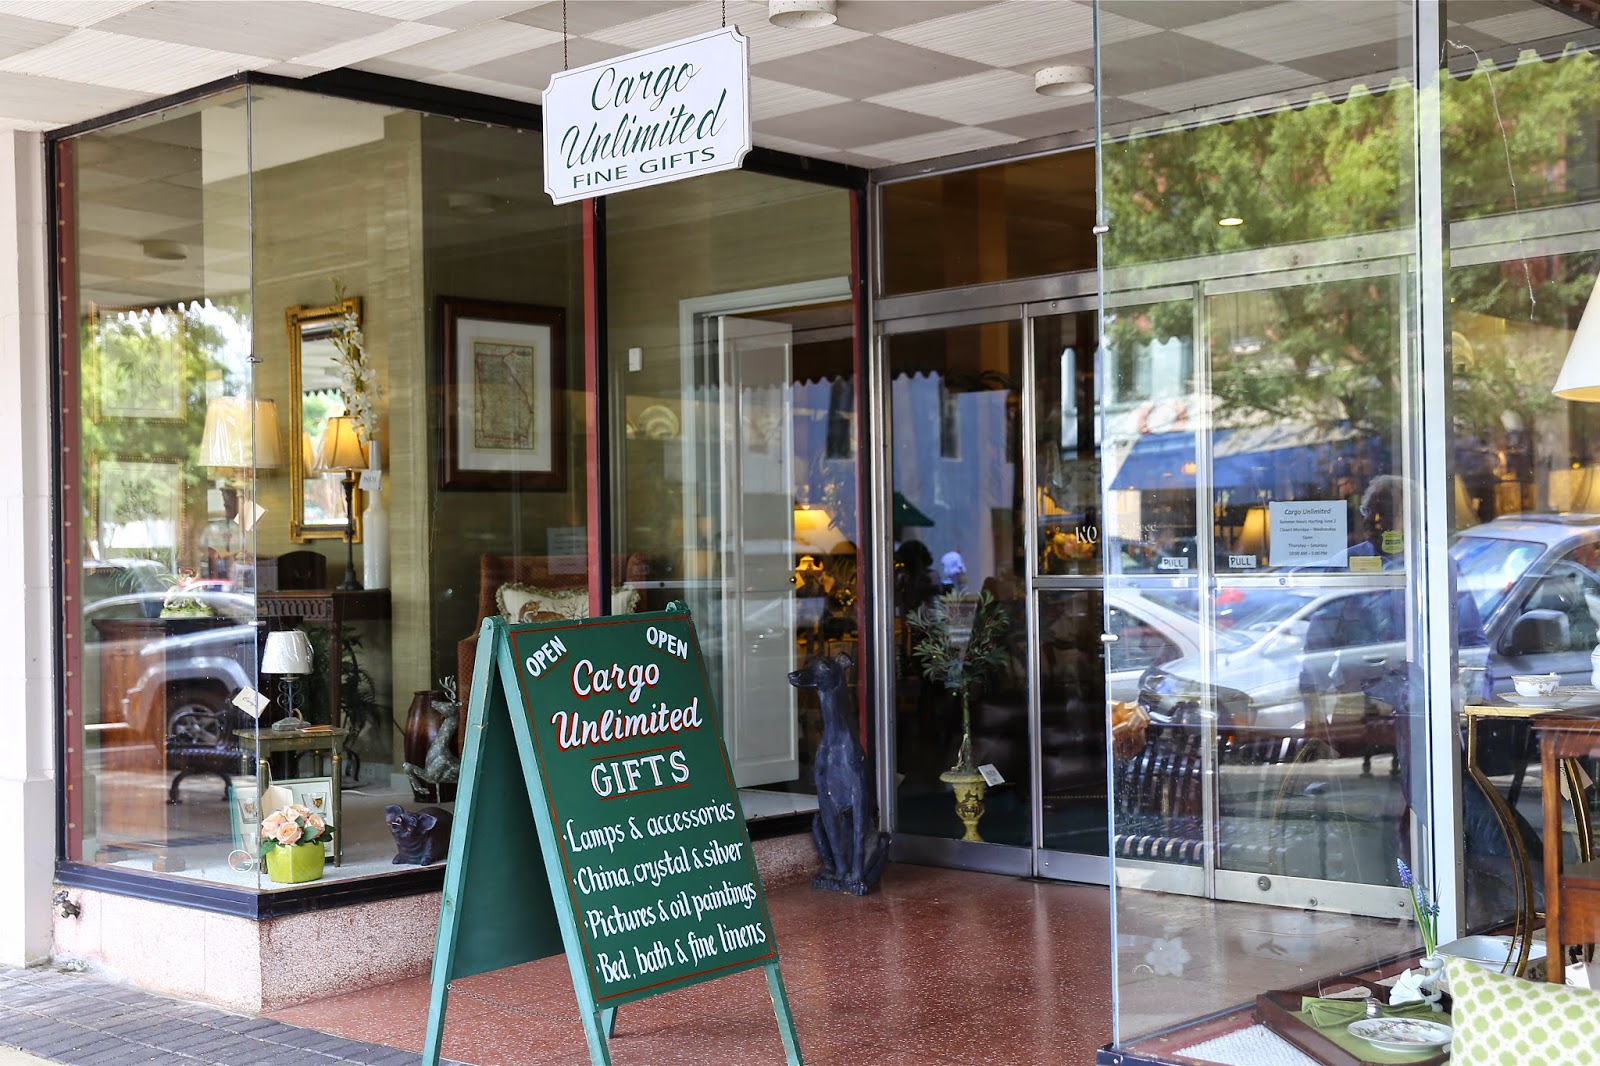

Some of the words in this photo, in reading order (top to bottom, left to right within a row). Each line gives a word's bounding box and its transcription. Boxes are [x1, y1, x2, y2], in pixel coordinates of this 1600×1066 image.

[592, 63, 701, 111] Cargo
[561, 88, 727, 169] Unlimited
[573, 165, 627, 188] FINE
[639, 147, 715, 173] GIFTS
[1230, 557, 1252, 566] PULL
[526, 635, 567, 677] OPEN
[646, 626, 688, 659] OPEN
[572, 659, 659, 704] Cargo
[551, 697, 702, 750] Unlimited
[591, 750, 689, 797] GIFTS
[566, 819, 625, 853] Lamps
[628, 816, 643, 840] &
[647, 799, 735, 837] accessories
[634, 846, 691, 887] crystal
[692, 848, 703, 869] &
[703, 839, 743, 867] silver
[586, 905, 656, 939] Pictures
[658, 899, 670, 923] &
[670, 891, 692, 919] oil
[692, 881, 757, 921] paintings
[597, 950, 637, 984] Bed,
[634, 941, 674, 974] bath
[675, 938, 689, 964] &
[688, 931, 718, 967] fine
[717, 922, 766, 953] linens
